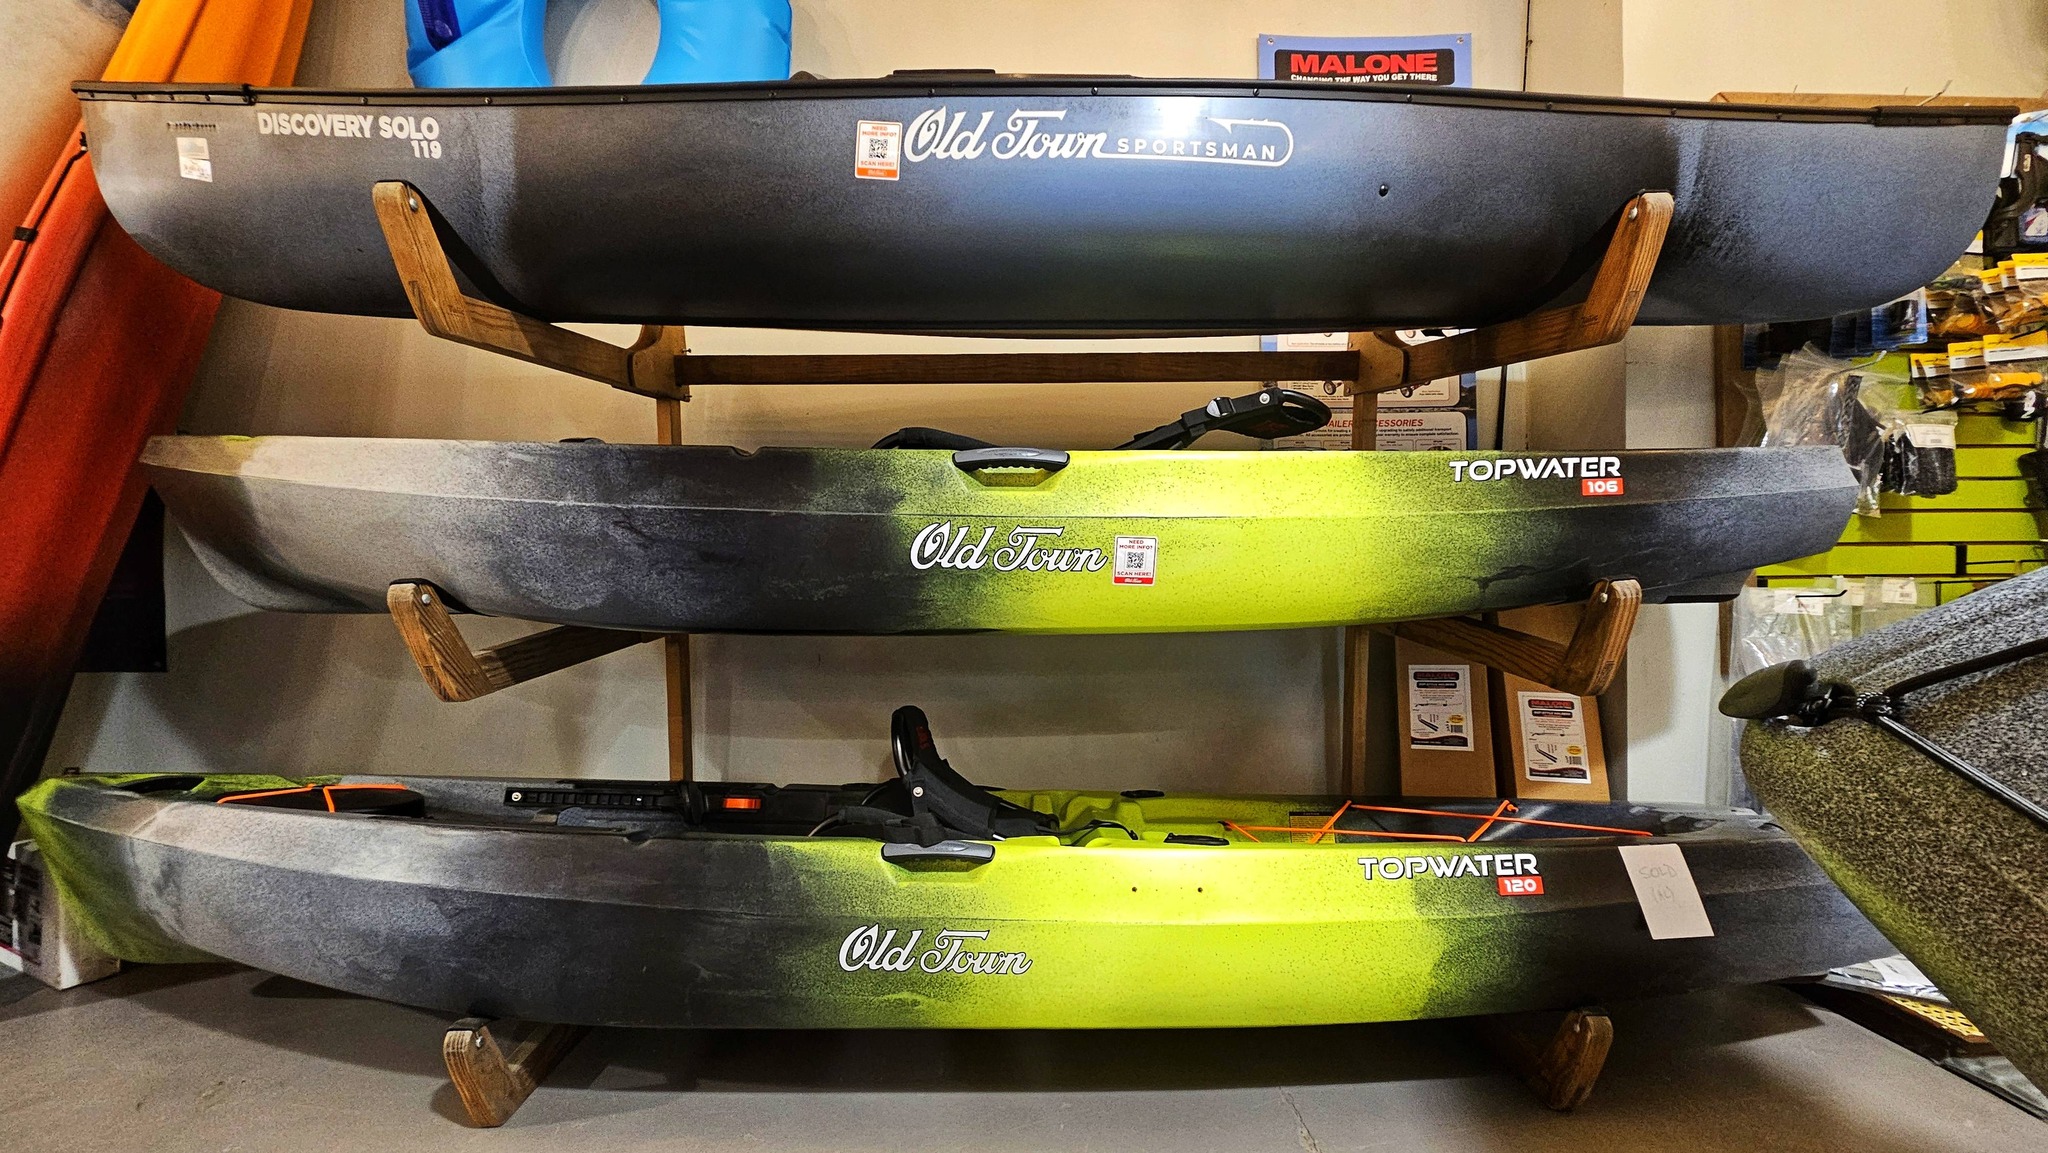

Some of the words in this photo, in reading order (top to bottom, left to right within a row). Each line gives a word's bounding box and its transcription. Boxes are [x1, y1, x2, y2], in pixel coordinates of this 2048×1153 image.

[1290, 52, 1438, 74] MALONE
[1352, 75, 1371, 83] WAY
[1373, 74, 1390, 82] YOU
[1391, 73, 1408, 81] GET
[1409, 73, 1438, 82] THERE
[257, 112, 374, 139] DISCOVERY
[378, 115, 440, 141] SOLO
[904, 105, 996, 163] Old
[991, 107, 1110, 160] Town
[1116, 136, 1276, 161] SPORTSMAN
[411, 140, 442, 160] 119
[1328, 419, 1353, 428] AILER
[1377, 418, 1424, 428] ESSORIES
[1449, 456, 1622, 482] TOPWATER
[1587, 480, 1619, 493] 106
[909, 520, 998, 571] Old
[992, 524, 1109, 573] Town
[1358, 853, 1540, 881] TOPWATER
[1638, 863, 1678, 879] SOLD
[1503, 878, 1538, 893] 120
[838, 922, 924, 972] Old
[920, 927, 1034, 975] Town
